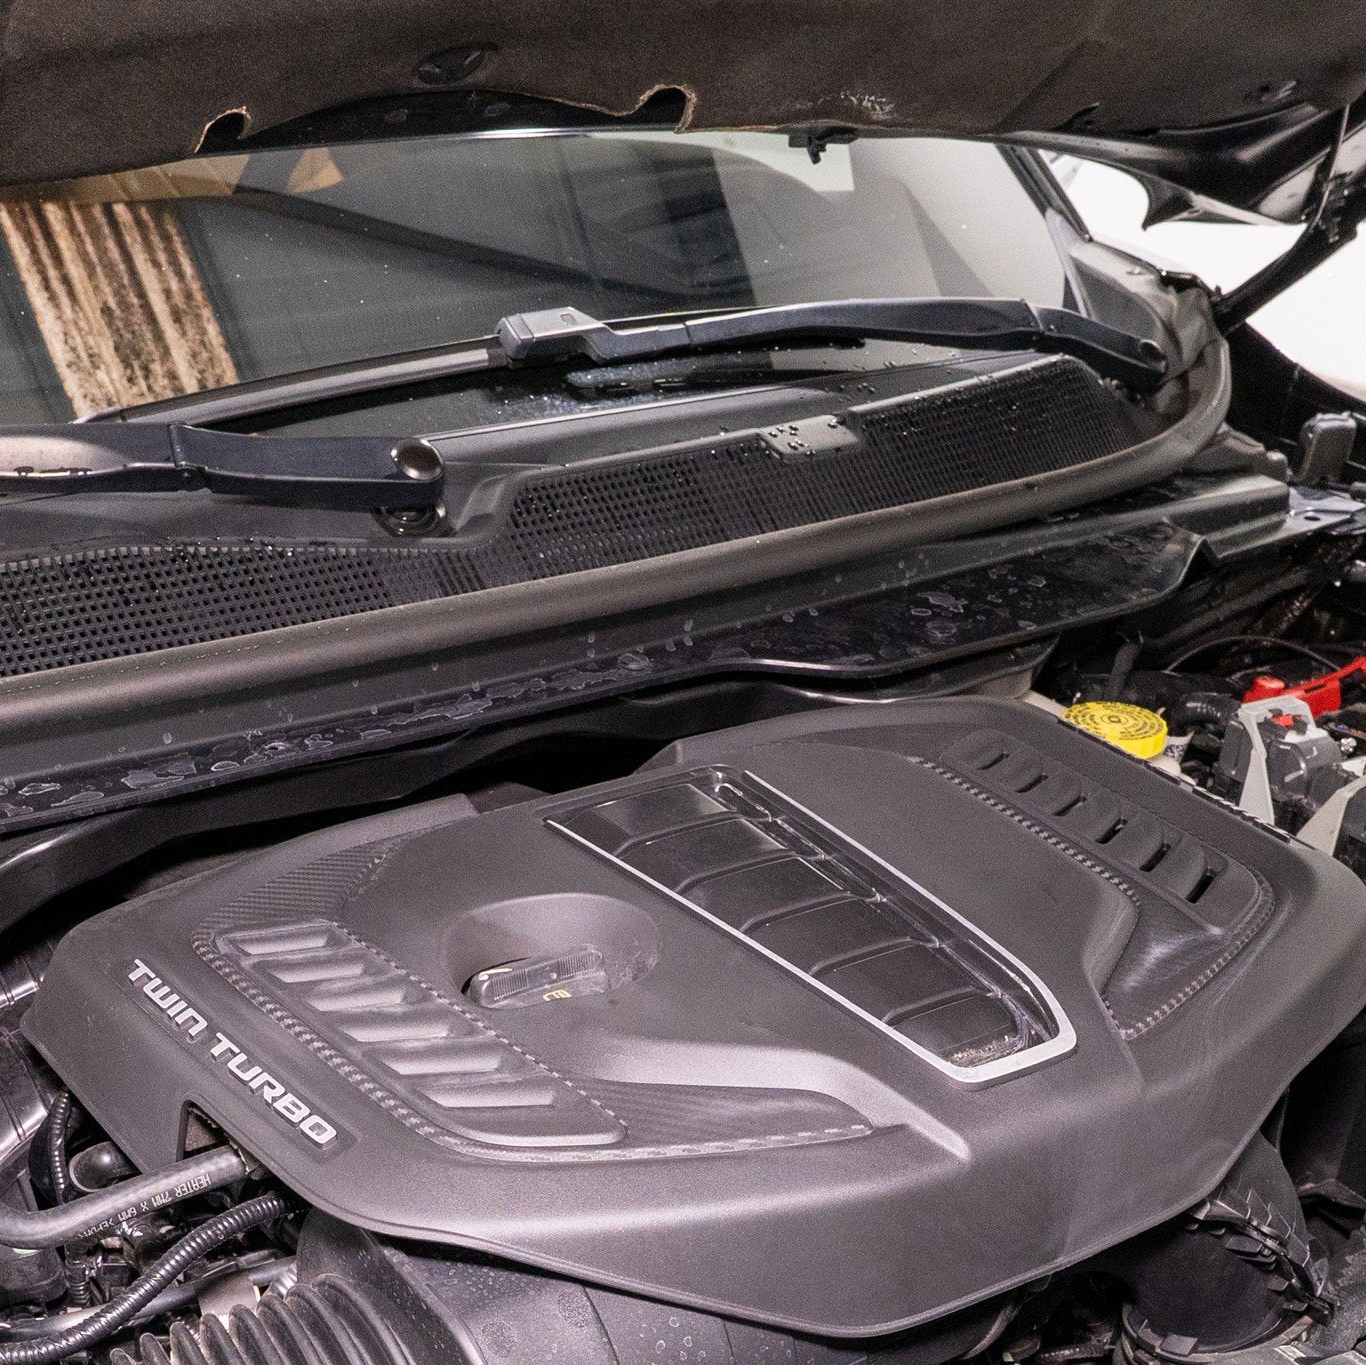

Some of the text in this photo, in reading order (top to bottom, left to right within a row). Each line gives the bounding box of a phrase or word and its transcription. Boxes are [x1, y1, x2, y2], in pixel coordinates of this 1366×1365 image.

[127, 958, 337, 1144] TWIN TURBO
[172, 1172, 212, 1198] HEATER
